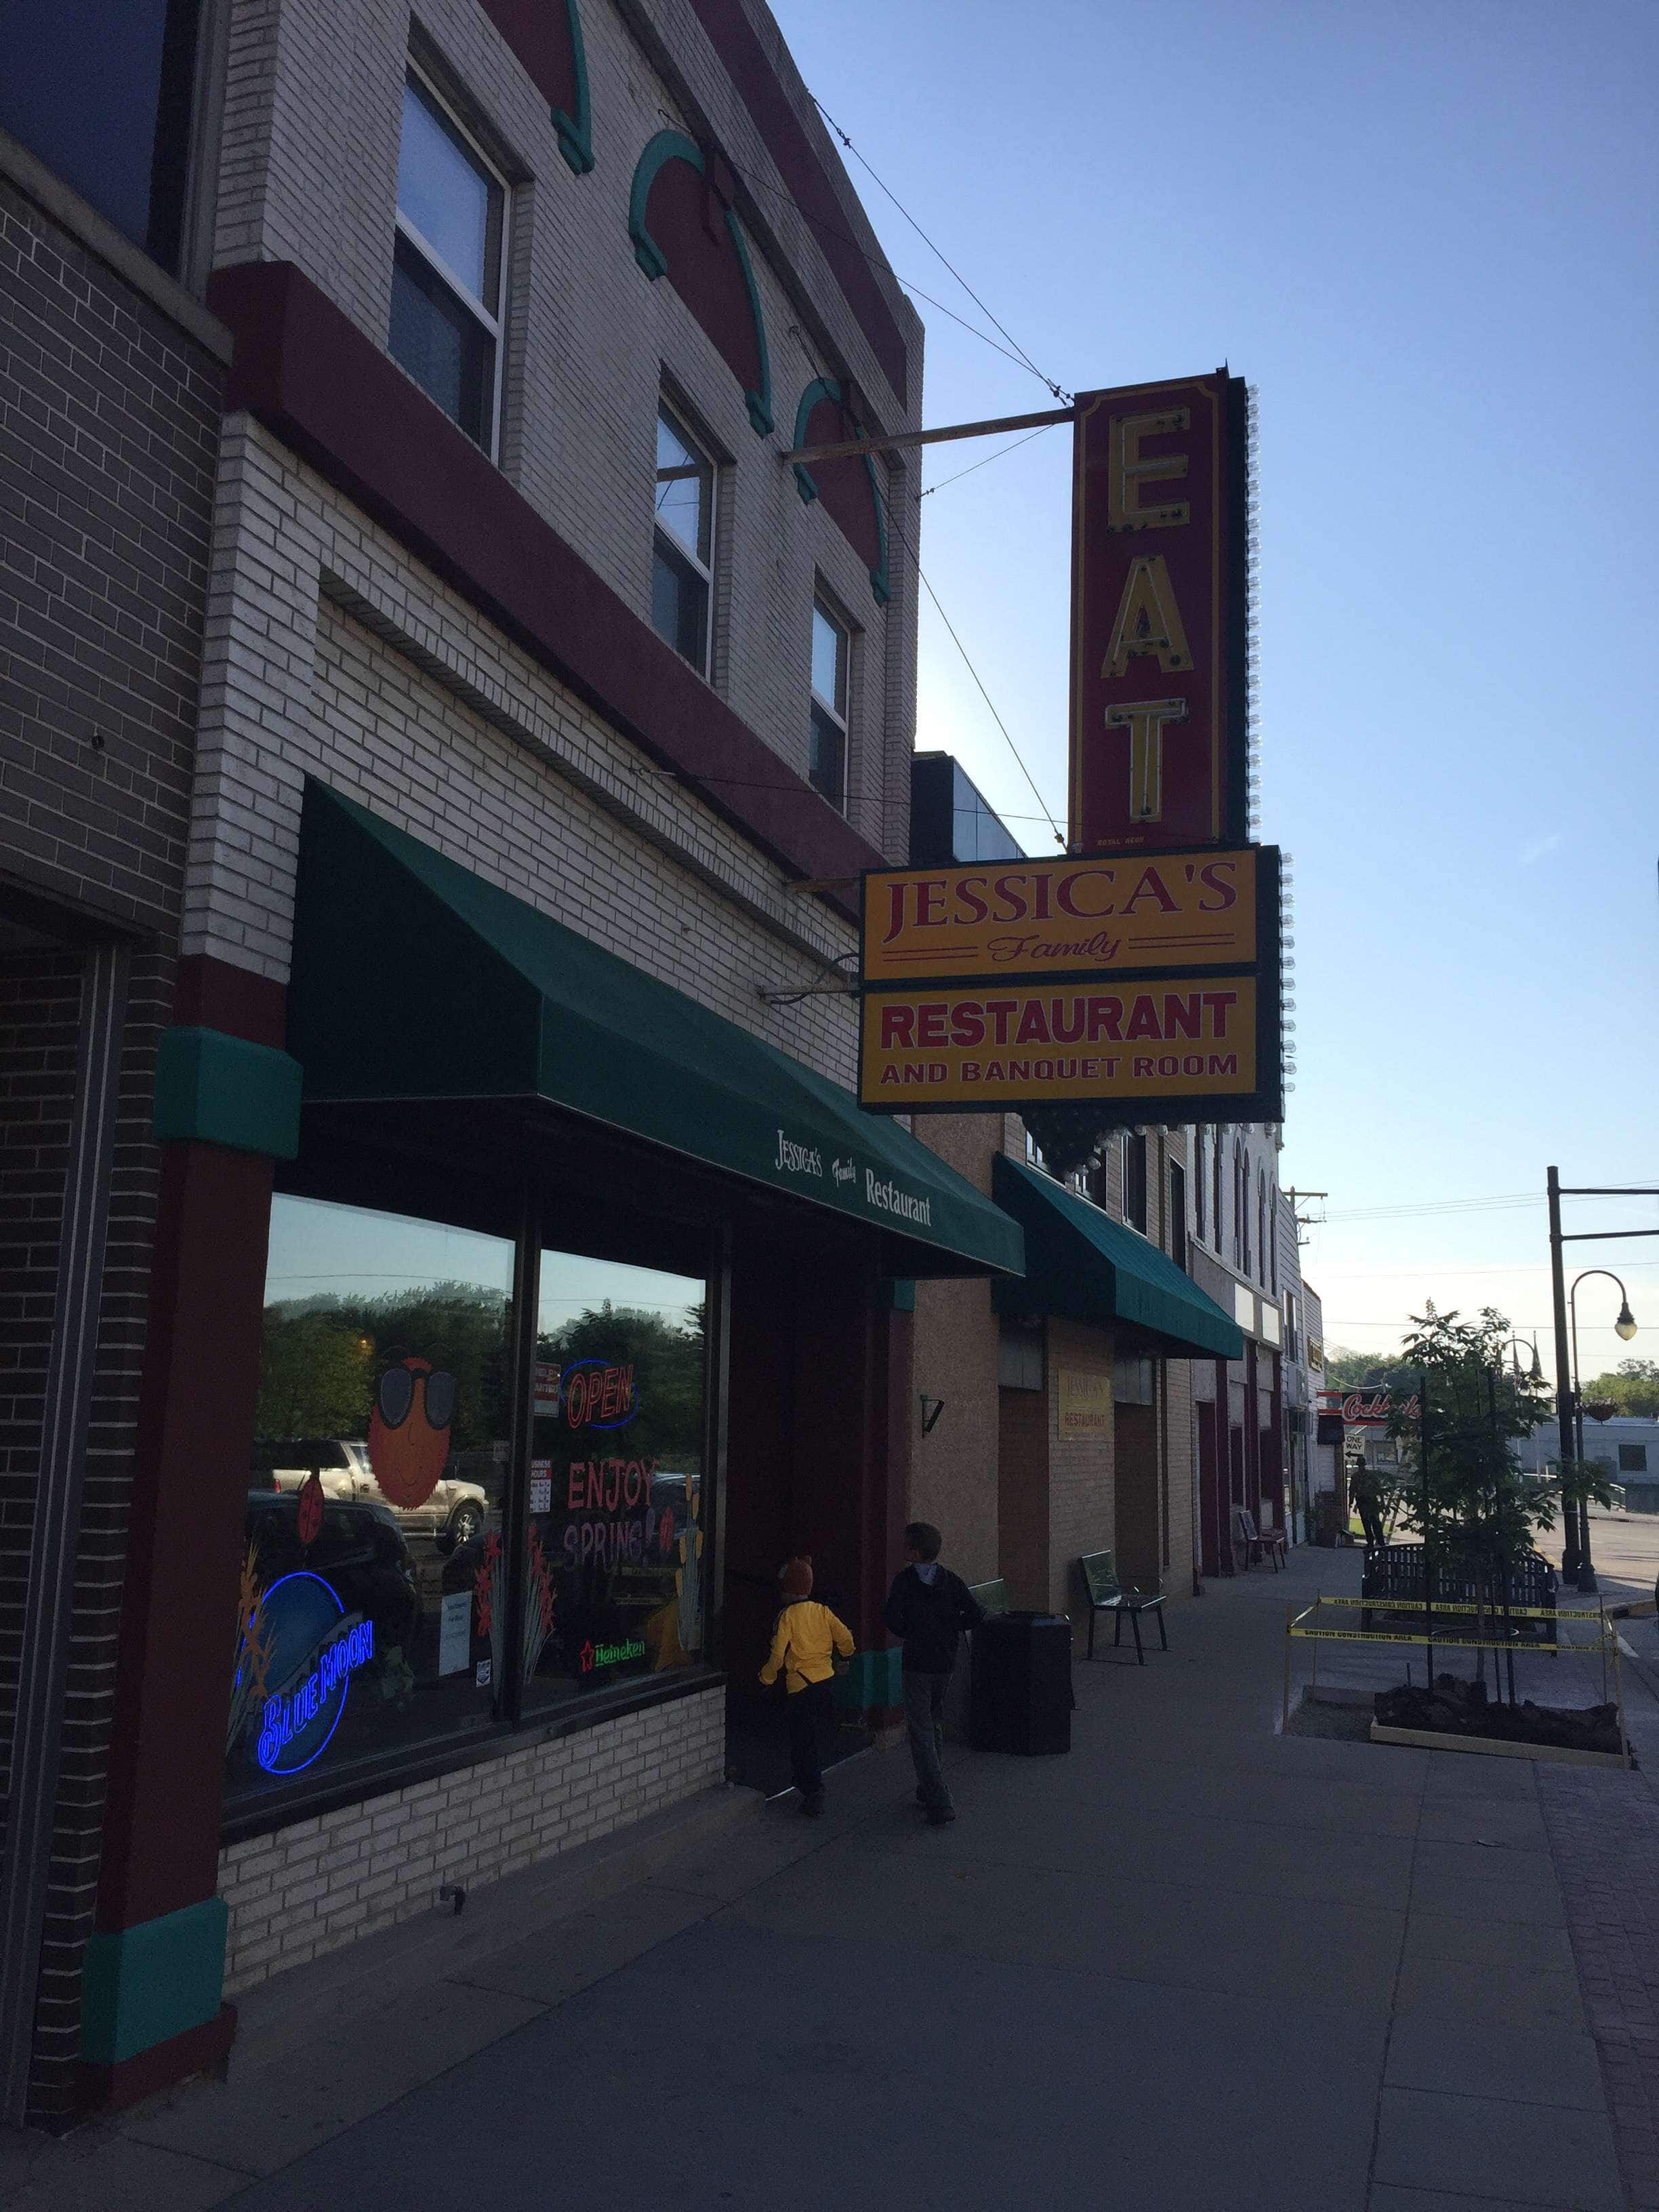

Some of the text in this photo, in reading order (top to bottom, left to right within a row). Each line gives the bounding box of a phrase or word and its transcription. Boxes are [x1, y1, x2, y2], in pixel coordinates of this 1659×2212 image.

[1101, 408, 1195, 825] EAT
[1097, 838, 1120, 846] ROYAL
[882, 861, 1237, 944] JESSICA'S
[987, 930, 1122, 962] Family
[881, 991, 1237, 1050] RESTAURANT
[881, 1052, 1238, 1085] AND BANQUET ROOM
[832, 1157, 857, 1187] Family
[865, 1168, 932, 1227] Restaurant
[567, 1364, 634, 1429] OPEN
[1346, 1442, 1363, 1450] WAY
[1347, 1435, 1362, 1443] ONE
[567, 1458, 660, 1512] ENJOY
[594, 1637, 645, 1667] Heineken
[257, 1620, 373, 1768] BLUE MOON
